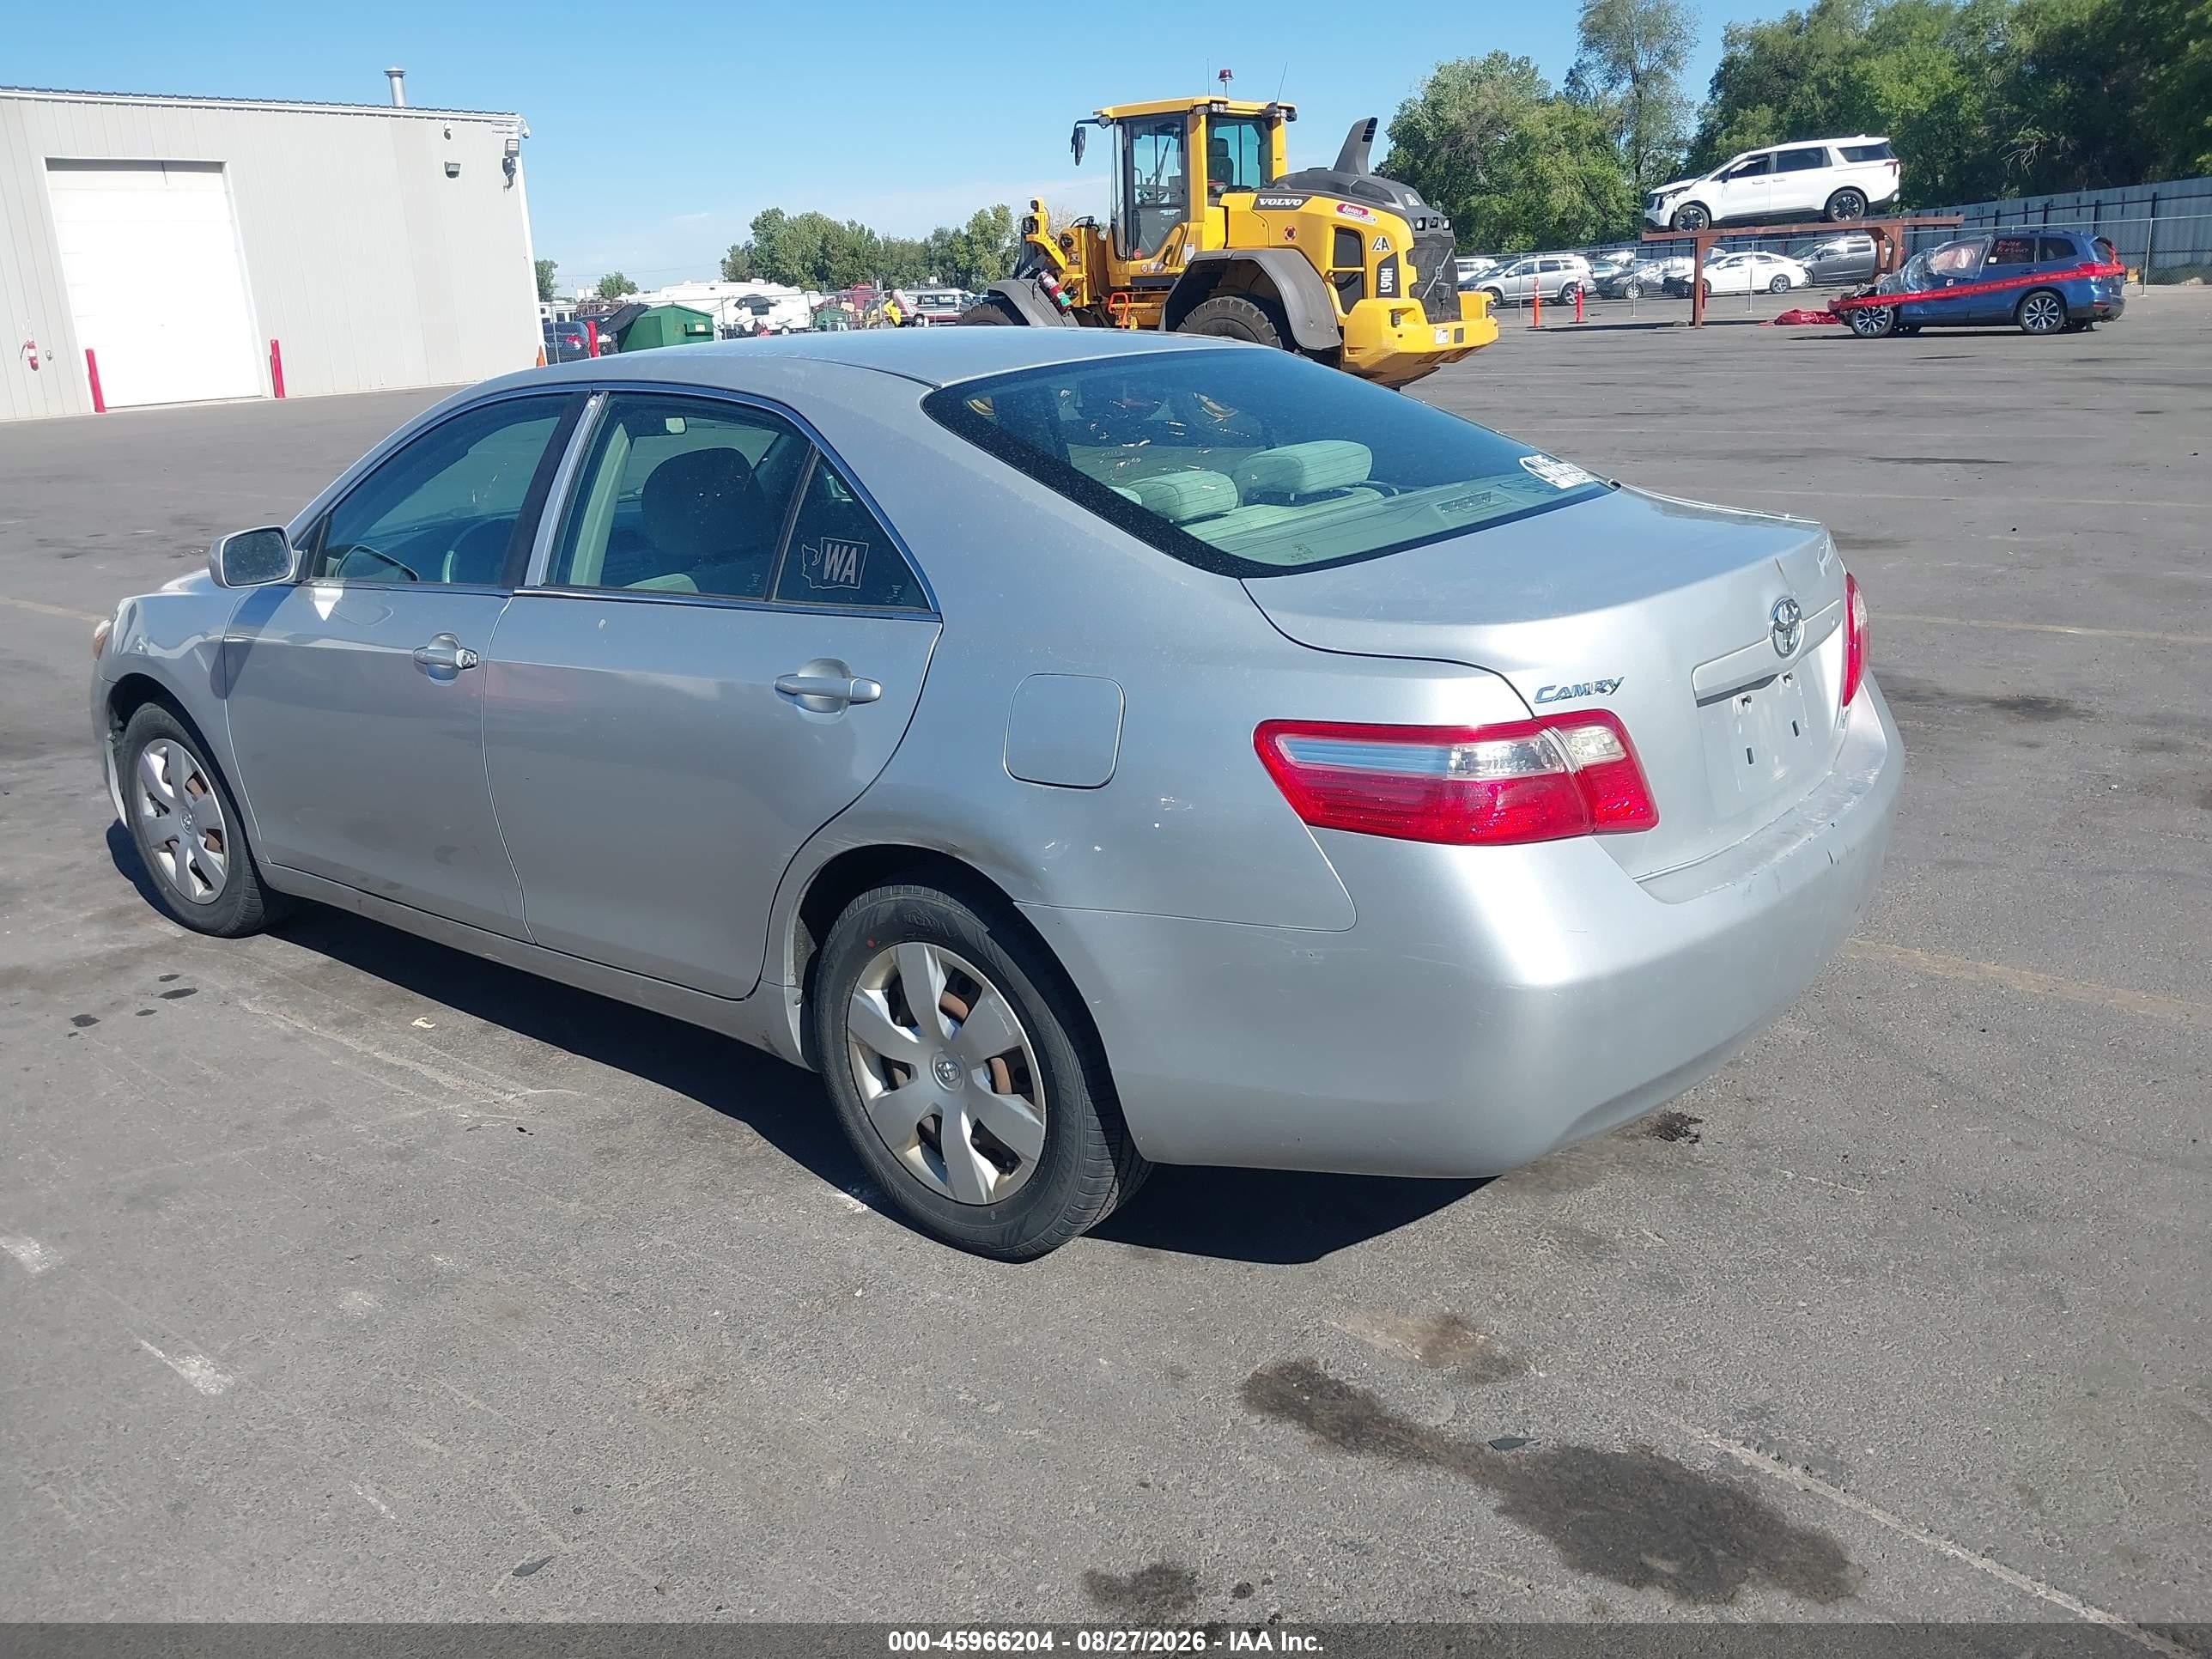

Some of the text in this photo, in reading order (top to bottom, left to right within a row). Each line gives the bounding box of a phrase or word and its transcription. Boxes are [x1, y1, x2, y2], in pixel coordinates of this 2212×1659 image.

[1259, 198, 1304, 207] VOLVO
[1380, 267, 1394, 293] L90H
[823, 543, 857, 585] WA
[1534, 675, 1626, 704] CAMRY
